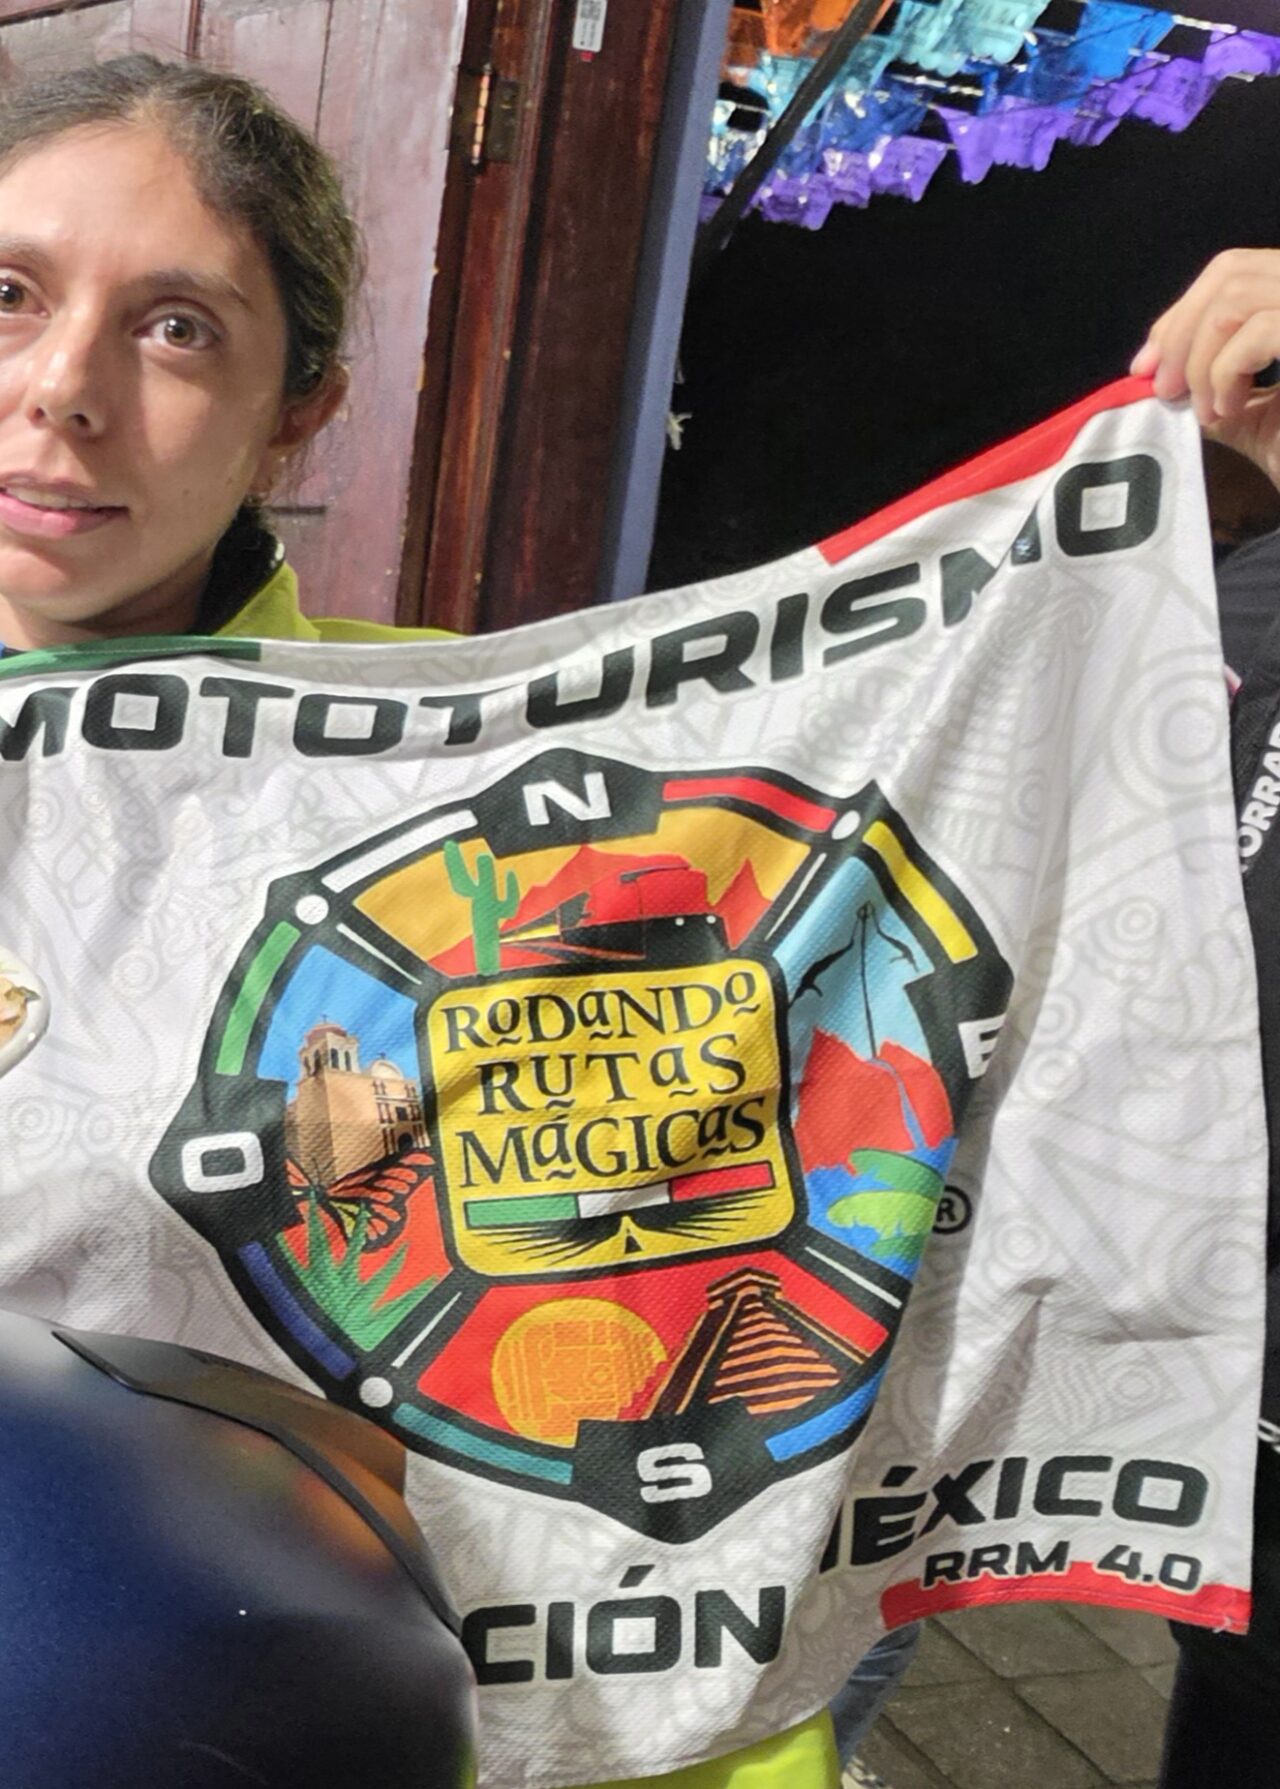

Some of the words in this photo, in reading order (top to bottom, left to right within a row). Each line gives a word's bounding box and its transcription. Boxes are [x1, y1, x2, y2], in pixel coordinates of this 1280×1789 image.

[522, 771, 613, 827] N
[181, 1131, 265, 1194] O
[636, 1442, 713, 1504] S
[461, 1563, 787, 1686] CIÓN
[819, 1455, 1210, 1575] ÉXICO
[922, 1540, 1071, 1588] RRM
[1096, 1544, 1202, 1592] 4.0
